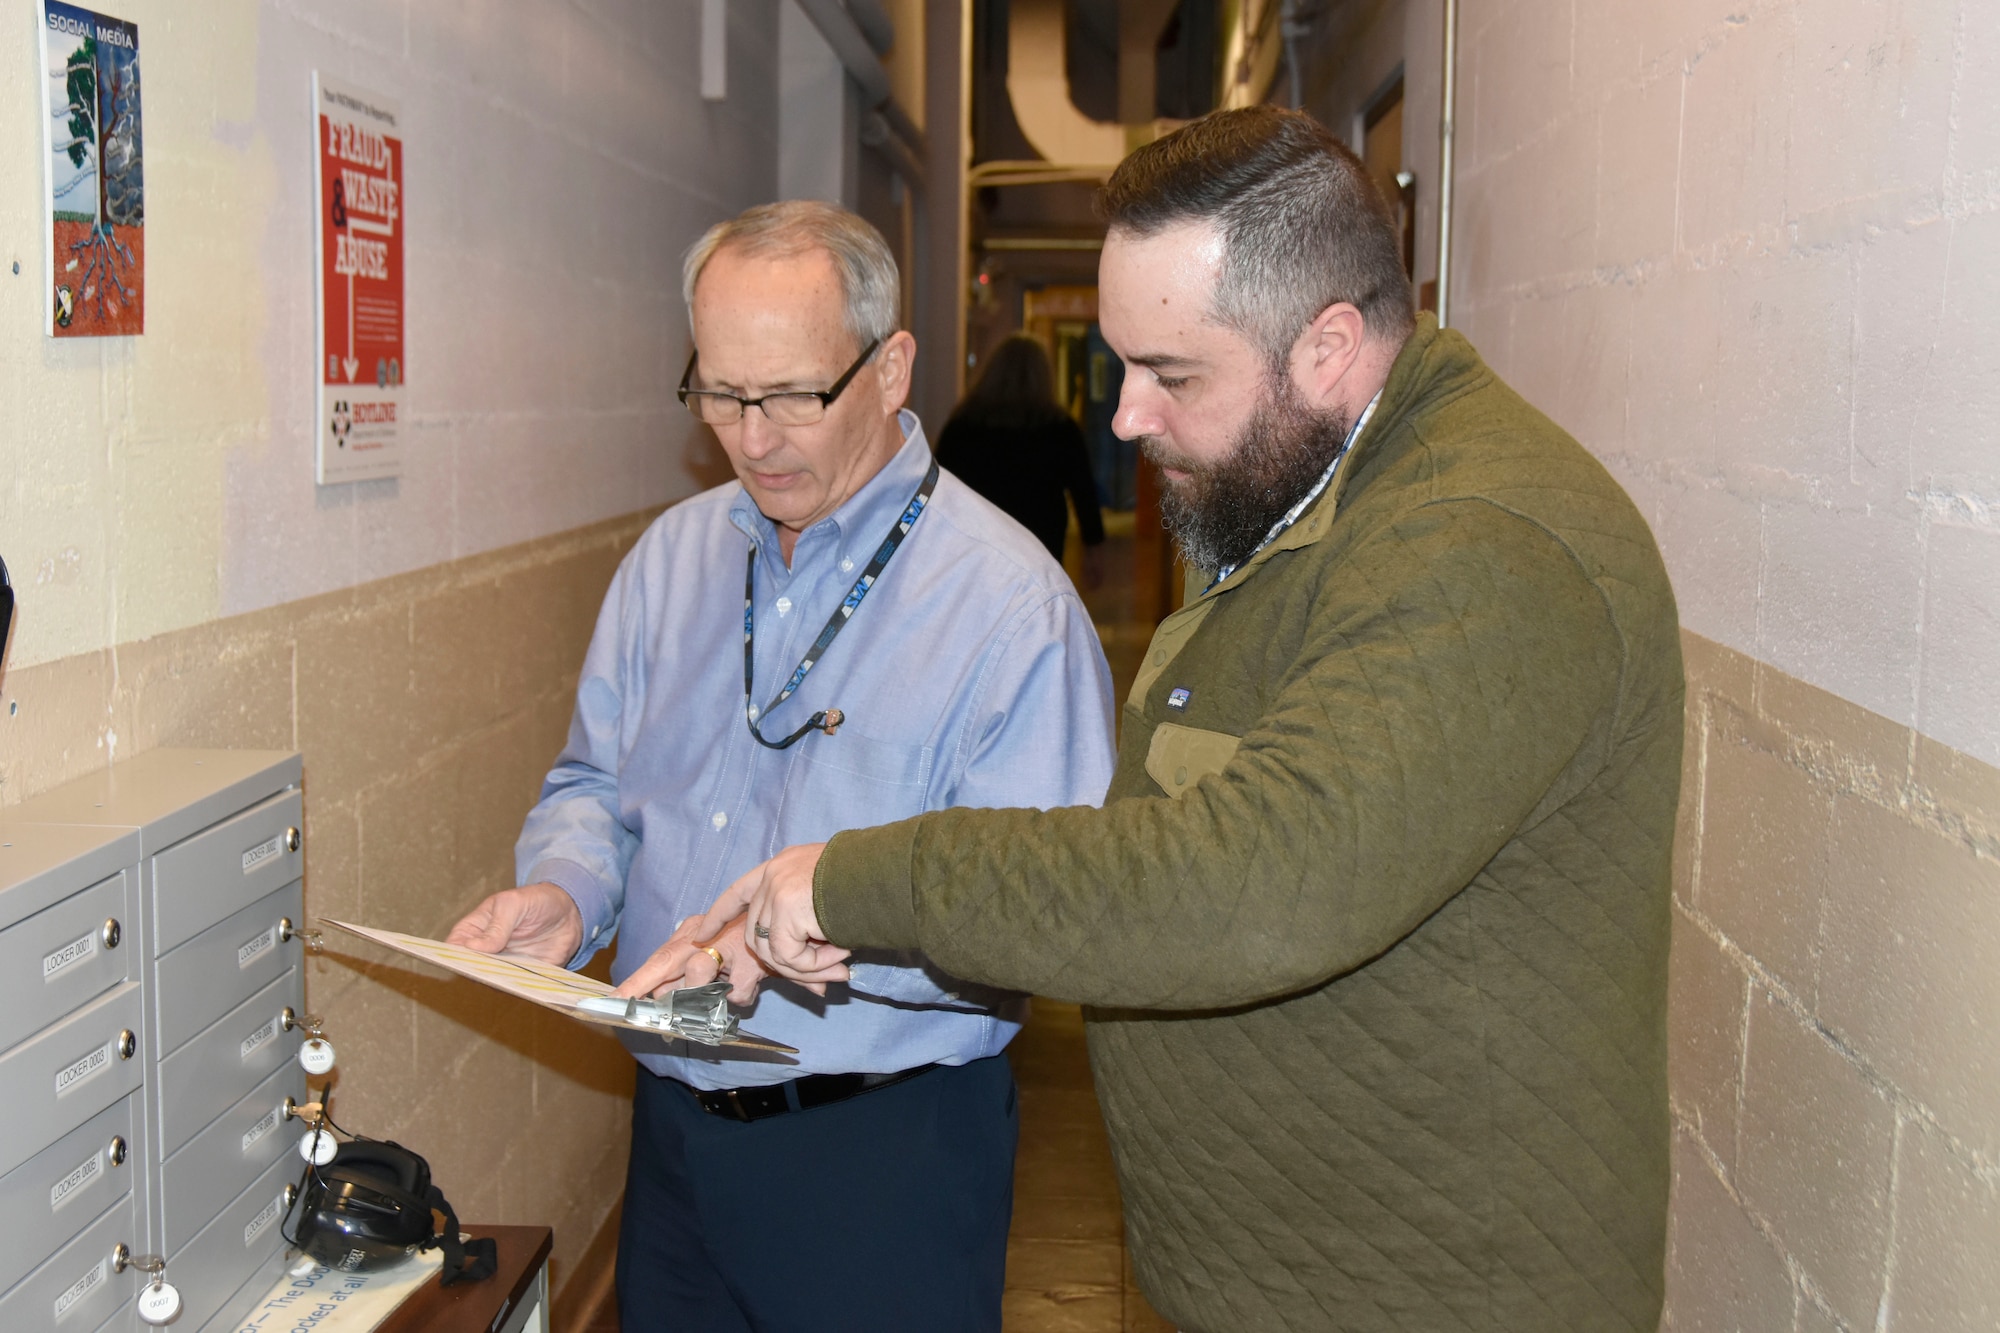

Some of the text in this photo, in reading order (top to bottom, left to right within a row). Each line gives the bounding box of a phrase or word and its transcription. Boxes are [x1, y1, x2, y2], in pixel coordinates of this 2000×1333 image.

[49, 13, 134, 49] SOCIAL MEDIA
[328, 117, 386, 170] FRAUD
[332, 178, 347, 227] &
[341, 169, 398, 220] WASTE
[335, 234, 388, 281] ABUSE
[352, 402, 396, 424] HOTLINE
[901, 496, 925, 525] NAS
[844, 577, 869, 609] NAS
[785, 662, 807, 693] NAS
[244, 845, 265, 865] LOCKER
[47, 938, 90, 972] LOCKER 0001
[240, 939, 260, 960] LOCKER
[59, 1049, 104, 1087] LOCKER 0003
[54, 1157, 97, 1200] LOCKER 0005
[246, 1212, 265, 1237] LOCKER
[58, 1266, 99, 1313] LOCKER 0007
[149, 1296, 169, 1308] 0007
[264, 1290, 305, 1309] The
[329, 1290, 354, 1302] at
[344, 1276, 369, 1289] all
